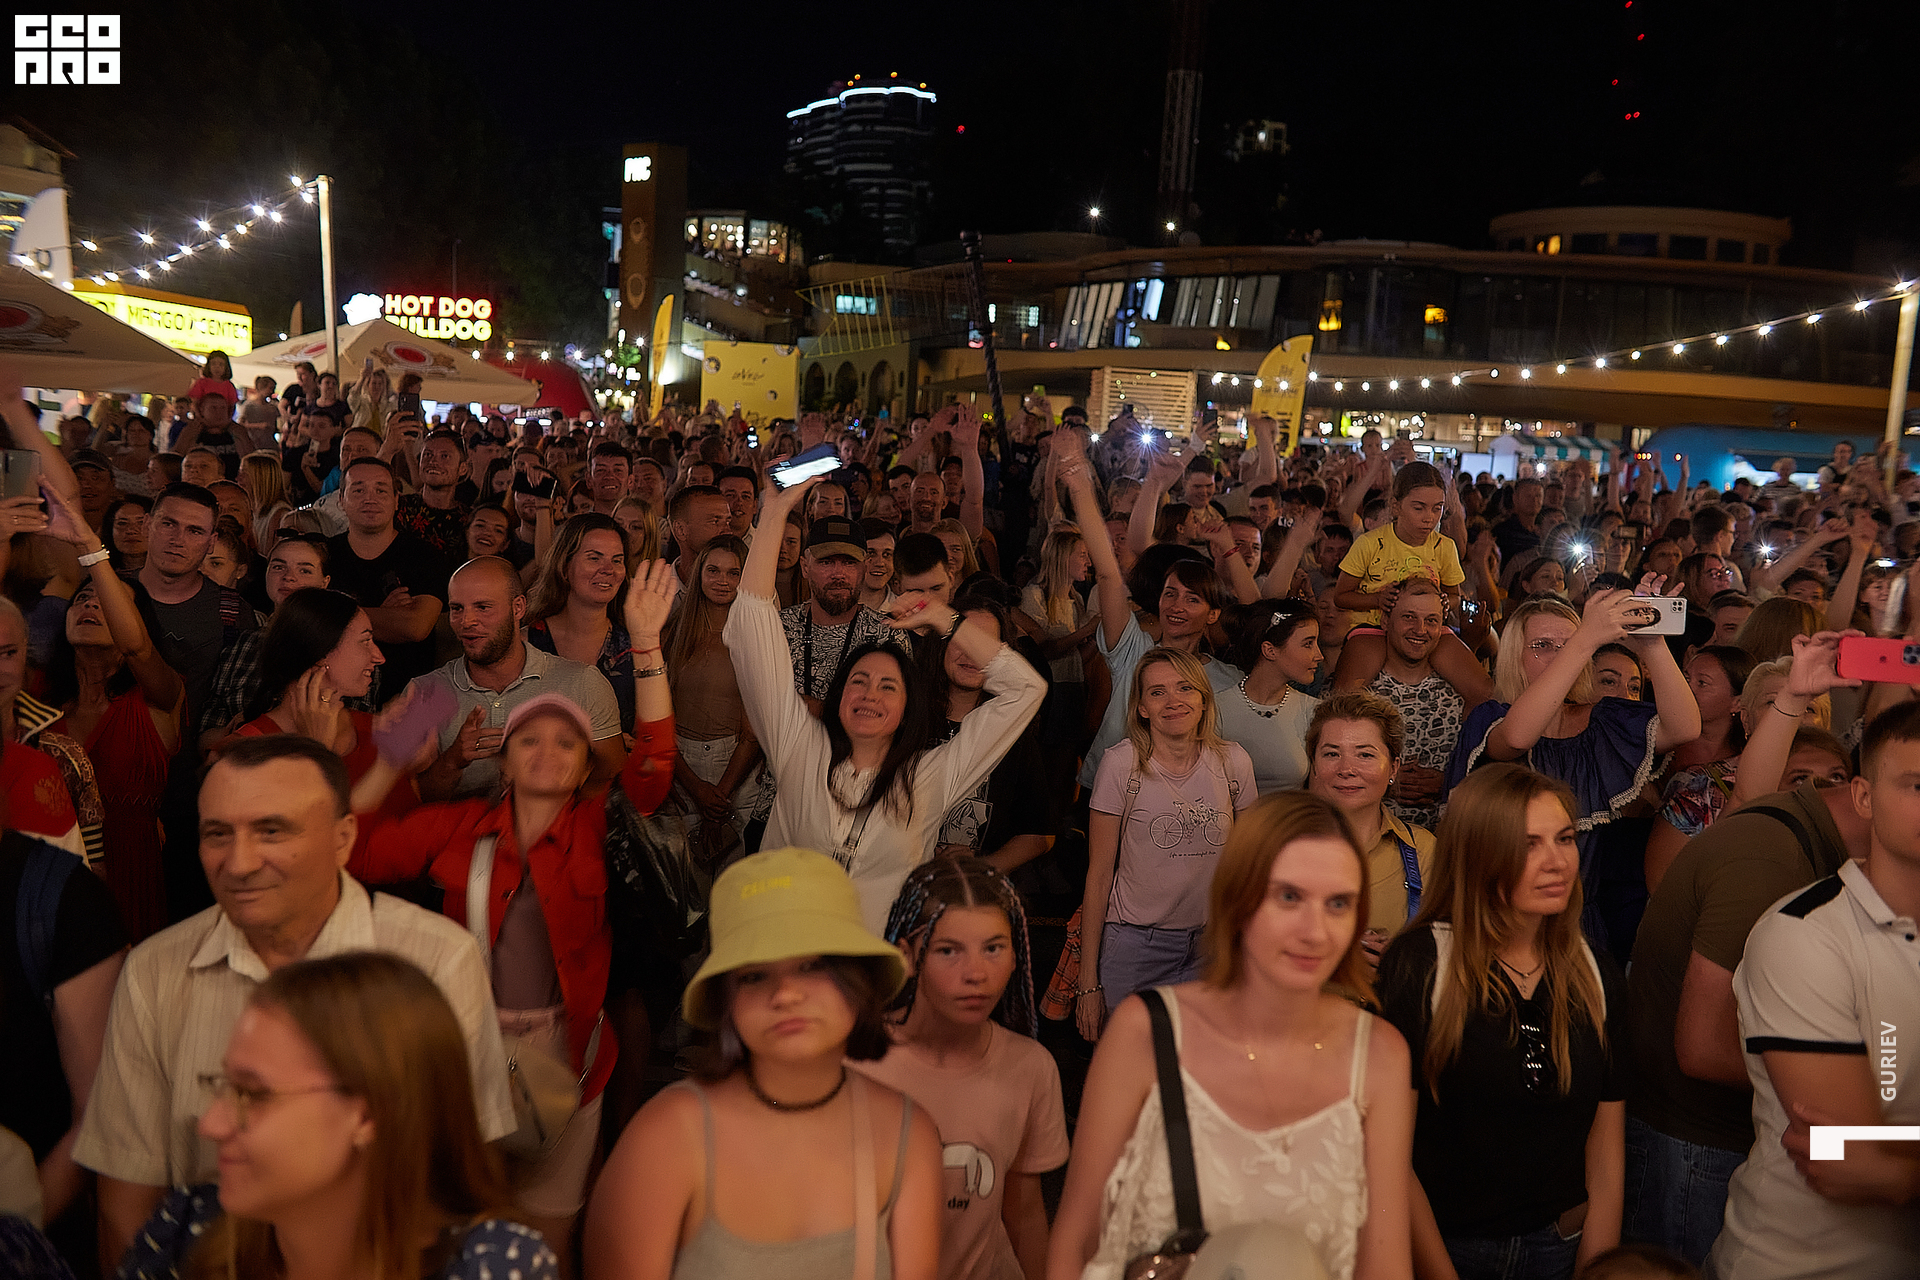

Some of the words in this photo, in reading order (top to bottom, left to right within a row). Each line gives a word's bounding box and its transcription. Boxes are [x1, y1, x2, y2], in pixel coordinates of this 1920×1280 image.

[384, 293, 435, 316] HOT
[438, 296, 493, 319] DOG
[947, 1195, 971, 1213] day
